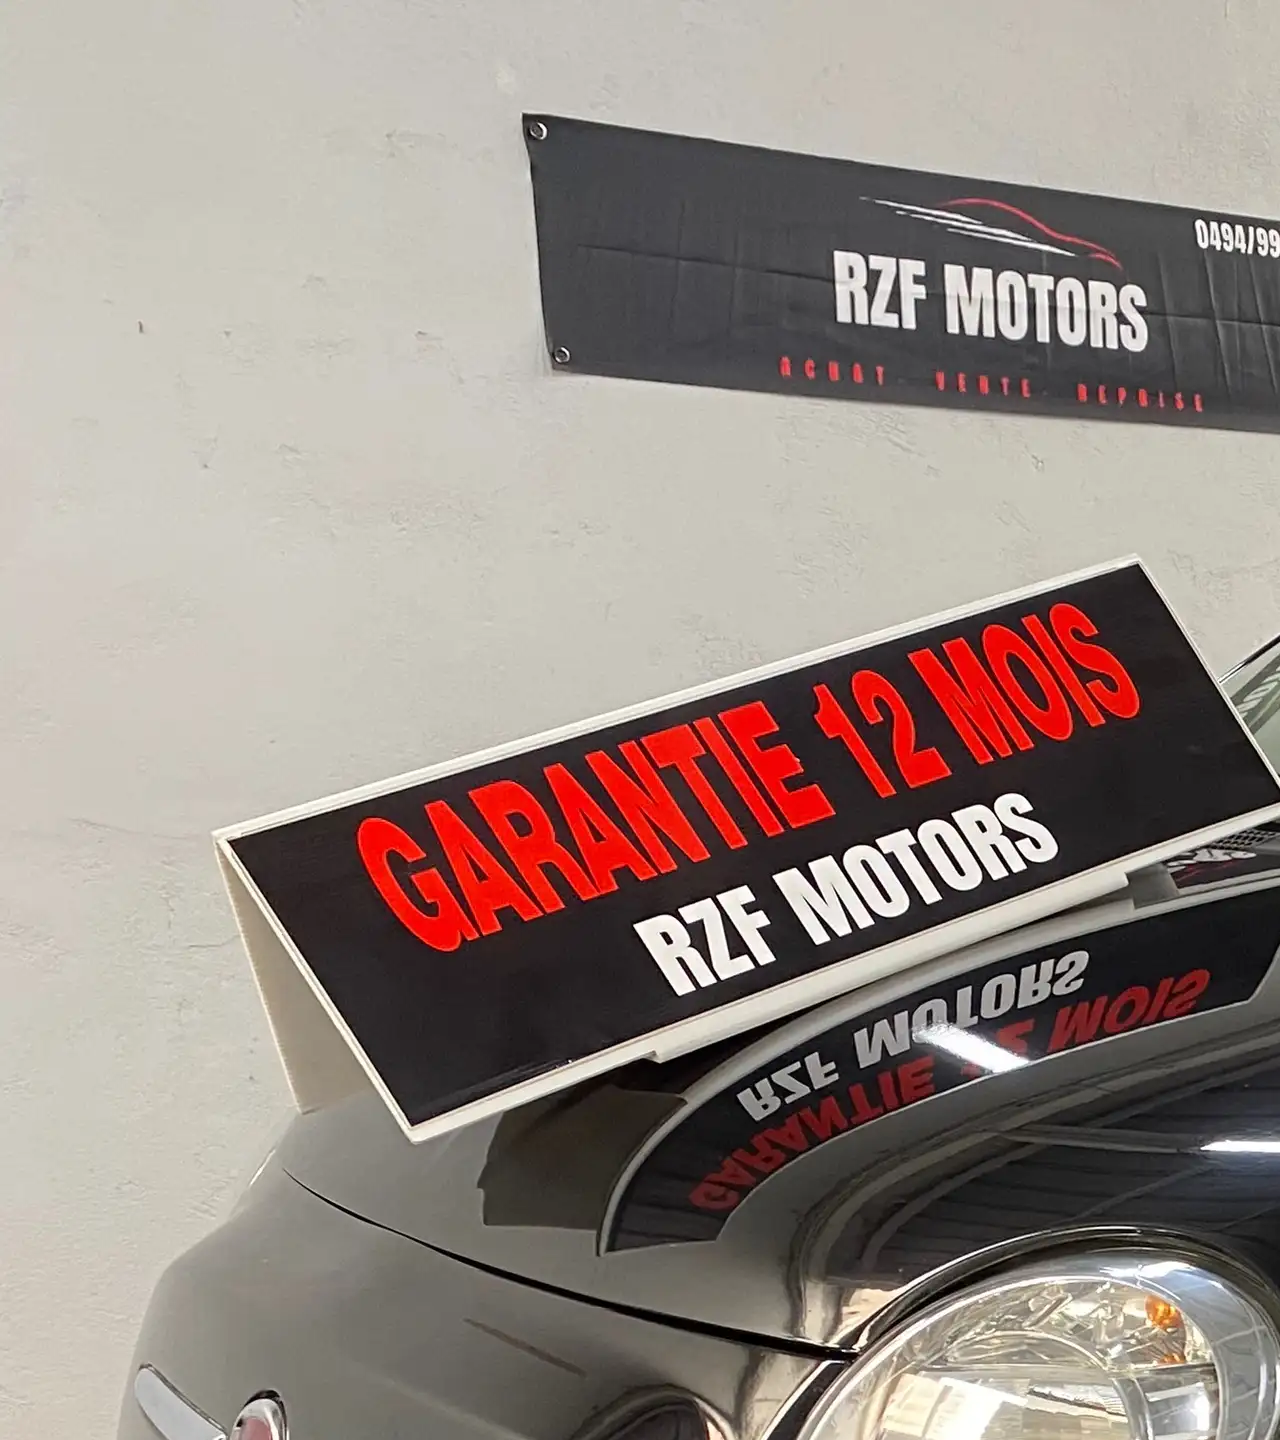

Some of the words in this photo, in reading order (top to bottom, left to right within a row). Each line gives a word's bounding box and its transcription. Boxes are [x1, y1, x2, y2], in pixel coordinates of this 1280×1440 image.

[833, 250, 927, 330] RZF
[943, 263, 1149, 353] MOTORS
[359, 700, 834, 953] GARANTIE
[813, 669, 952, 799] 12
[908, 602, 1141, 766] MOIS
[632, 884, 777, 997] RZF
[779, 793, 1059, 946] MOTORS
